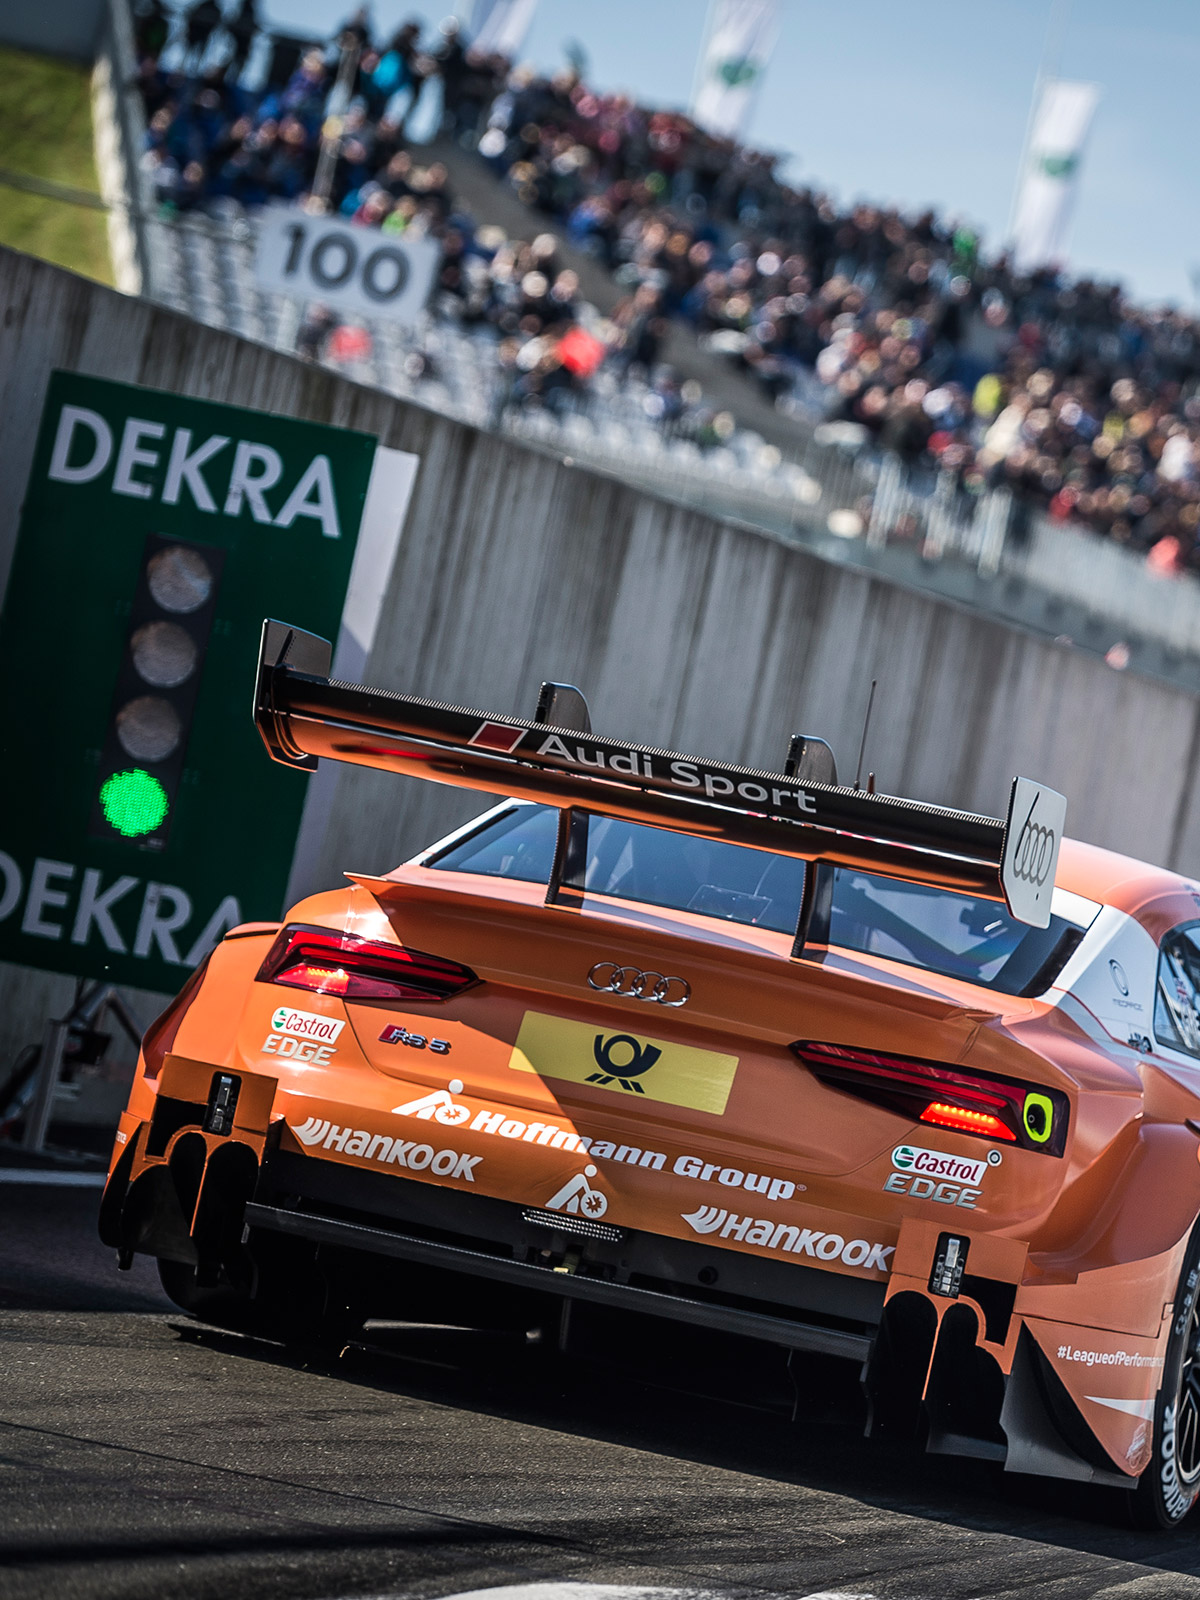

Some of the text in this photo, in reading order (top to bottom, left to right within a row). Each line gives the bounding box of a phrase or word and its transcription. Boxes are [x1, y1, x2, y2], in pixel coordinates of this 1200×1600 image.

[281, 222, 411, 305] 100
[47, 404, 342, 539] DEKRA
[536, 734, 818, 815] Audi Sport
[261, 1033, 340, 1067] EDGE
[285, 1012, 338, 1041] Castrol
[469, 1109, 668, 1171] Hoffmann
[883, 1172, 984, 1210] EDGE
[913, 1151, 981, 1183] Castrol
